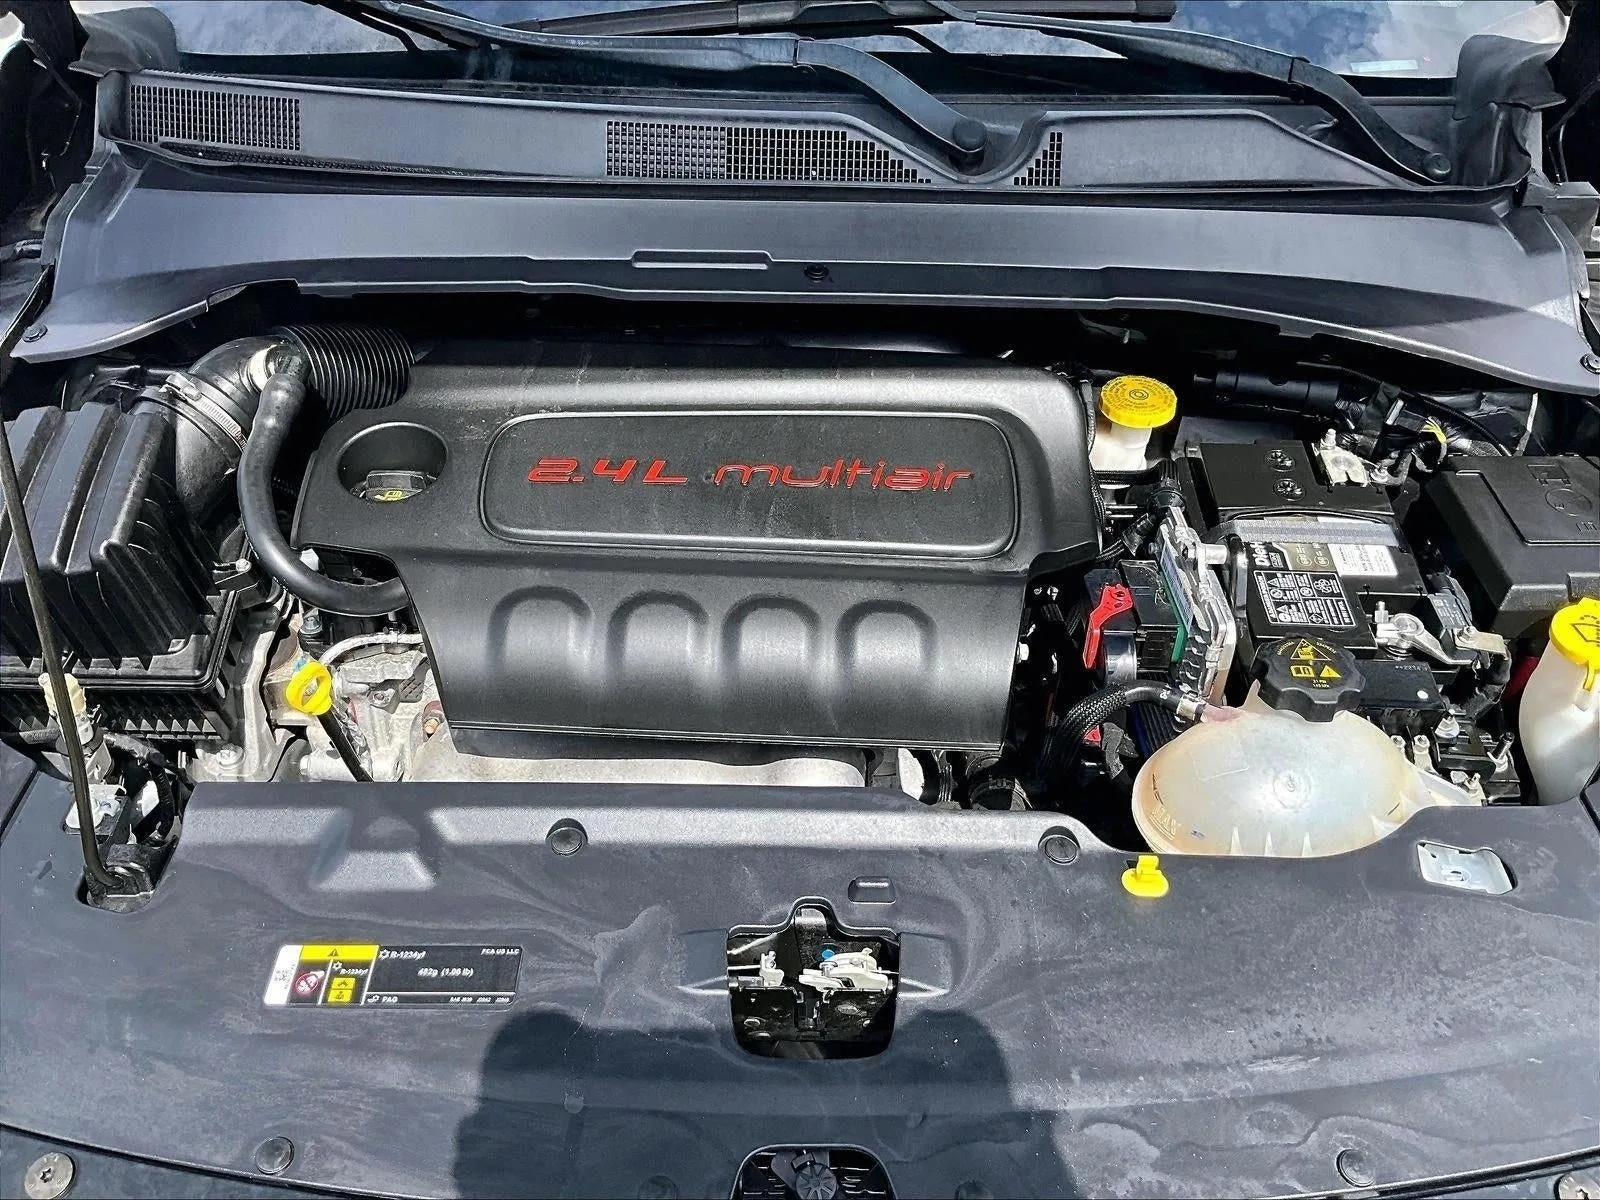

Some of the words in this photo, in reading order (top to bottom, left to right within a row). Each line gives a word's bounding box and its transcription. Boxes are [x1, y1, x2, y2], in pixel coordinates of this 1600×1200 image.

[714, 458, 975, 491] multiair
[390, 950, 427, 961] R-1234yf
[382, 995, 399, 1003] PAG
